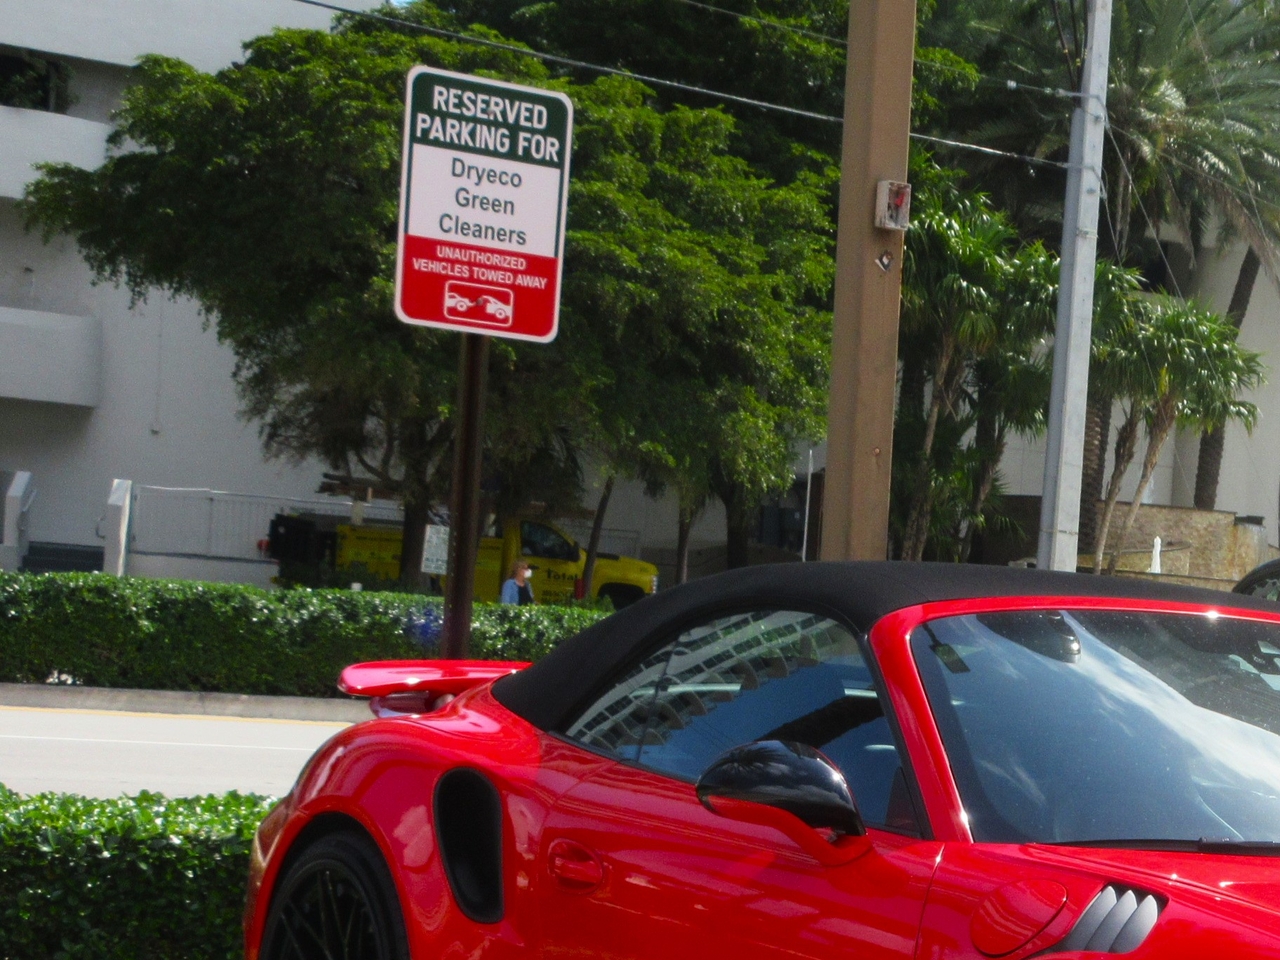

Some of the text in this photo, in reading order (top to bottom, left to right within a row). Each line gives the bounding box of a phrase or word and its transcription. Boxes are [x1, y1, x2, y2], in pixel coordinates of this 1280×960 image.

[433, 85, 547, 130] RESERVED
[416, 113, 560, 162] PARKING FOR
[452, 157, 522, 188] Dryeco
[455, 187, 515, 215] Green
[439, 213, 527, 245] Cleaners
[413, 257, 547, 289] VEHICLES TOWED AWAY
[436, 245, 527, 270] UNAUTHORIZED
